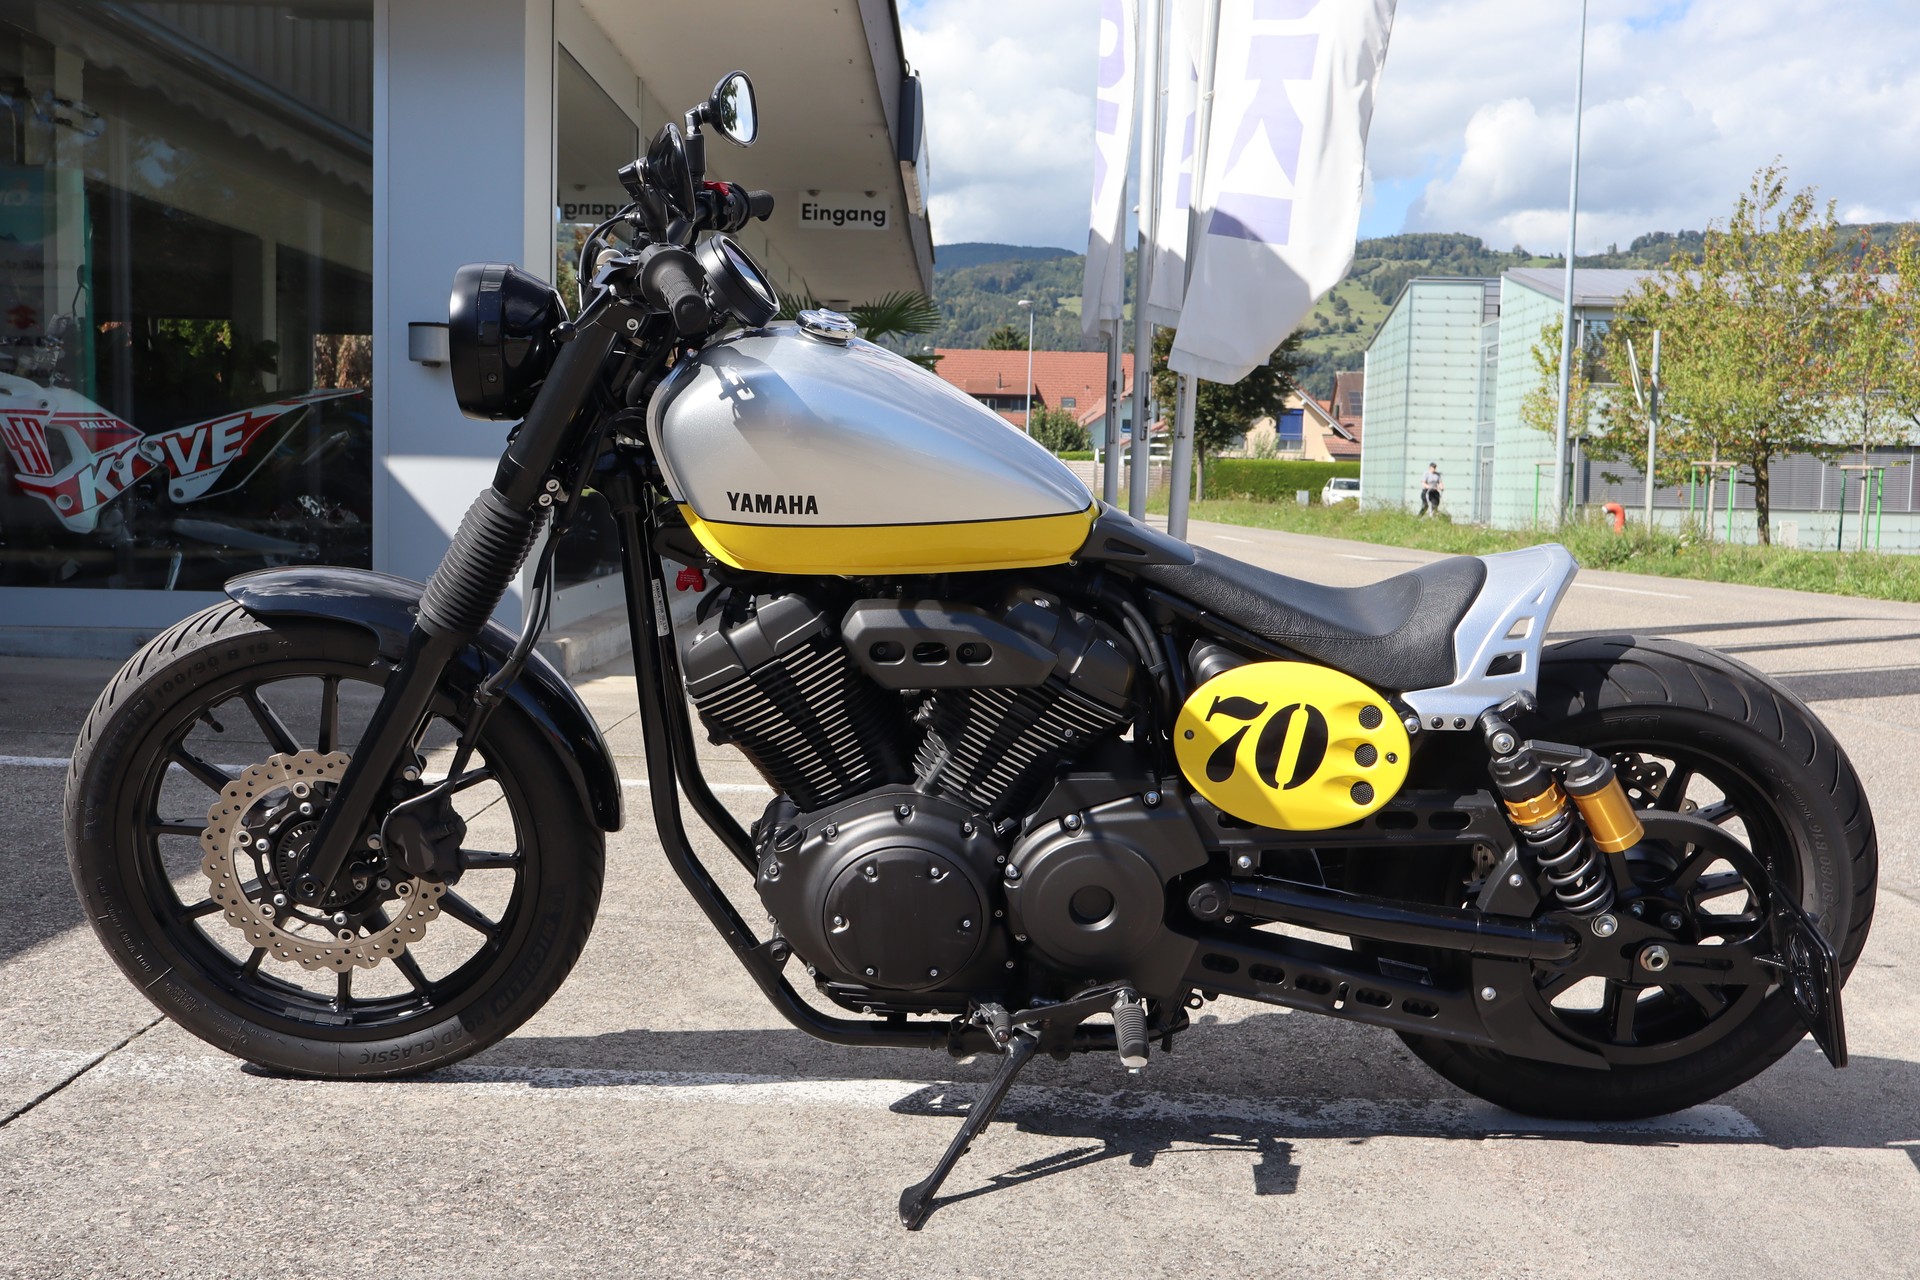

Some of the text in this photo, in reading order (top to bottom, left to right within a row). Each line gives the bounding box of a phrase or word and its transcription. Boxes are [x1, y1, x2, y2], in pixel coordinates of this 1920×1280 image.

[801, 202, 887, 227] Eingang
[79, 420, 118, 430] RALLY
[78, 415, 247, 510] KOVE
[726, 491, 819, 515] YAMAHA
[1205, 696, 1329, 790] 70
[441, 1014, 487, 1045] ROAD
[358, 1039, 436, 1065] CLASSIC
